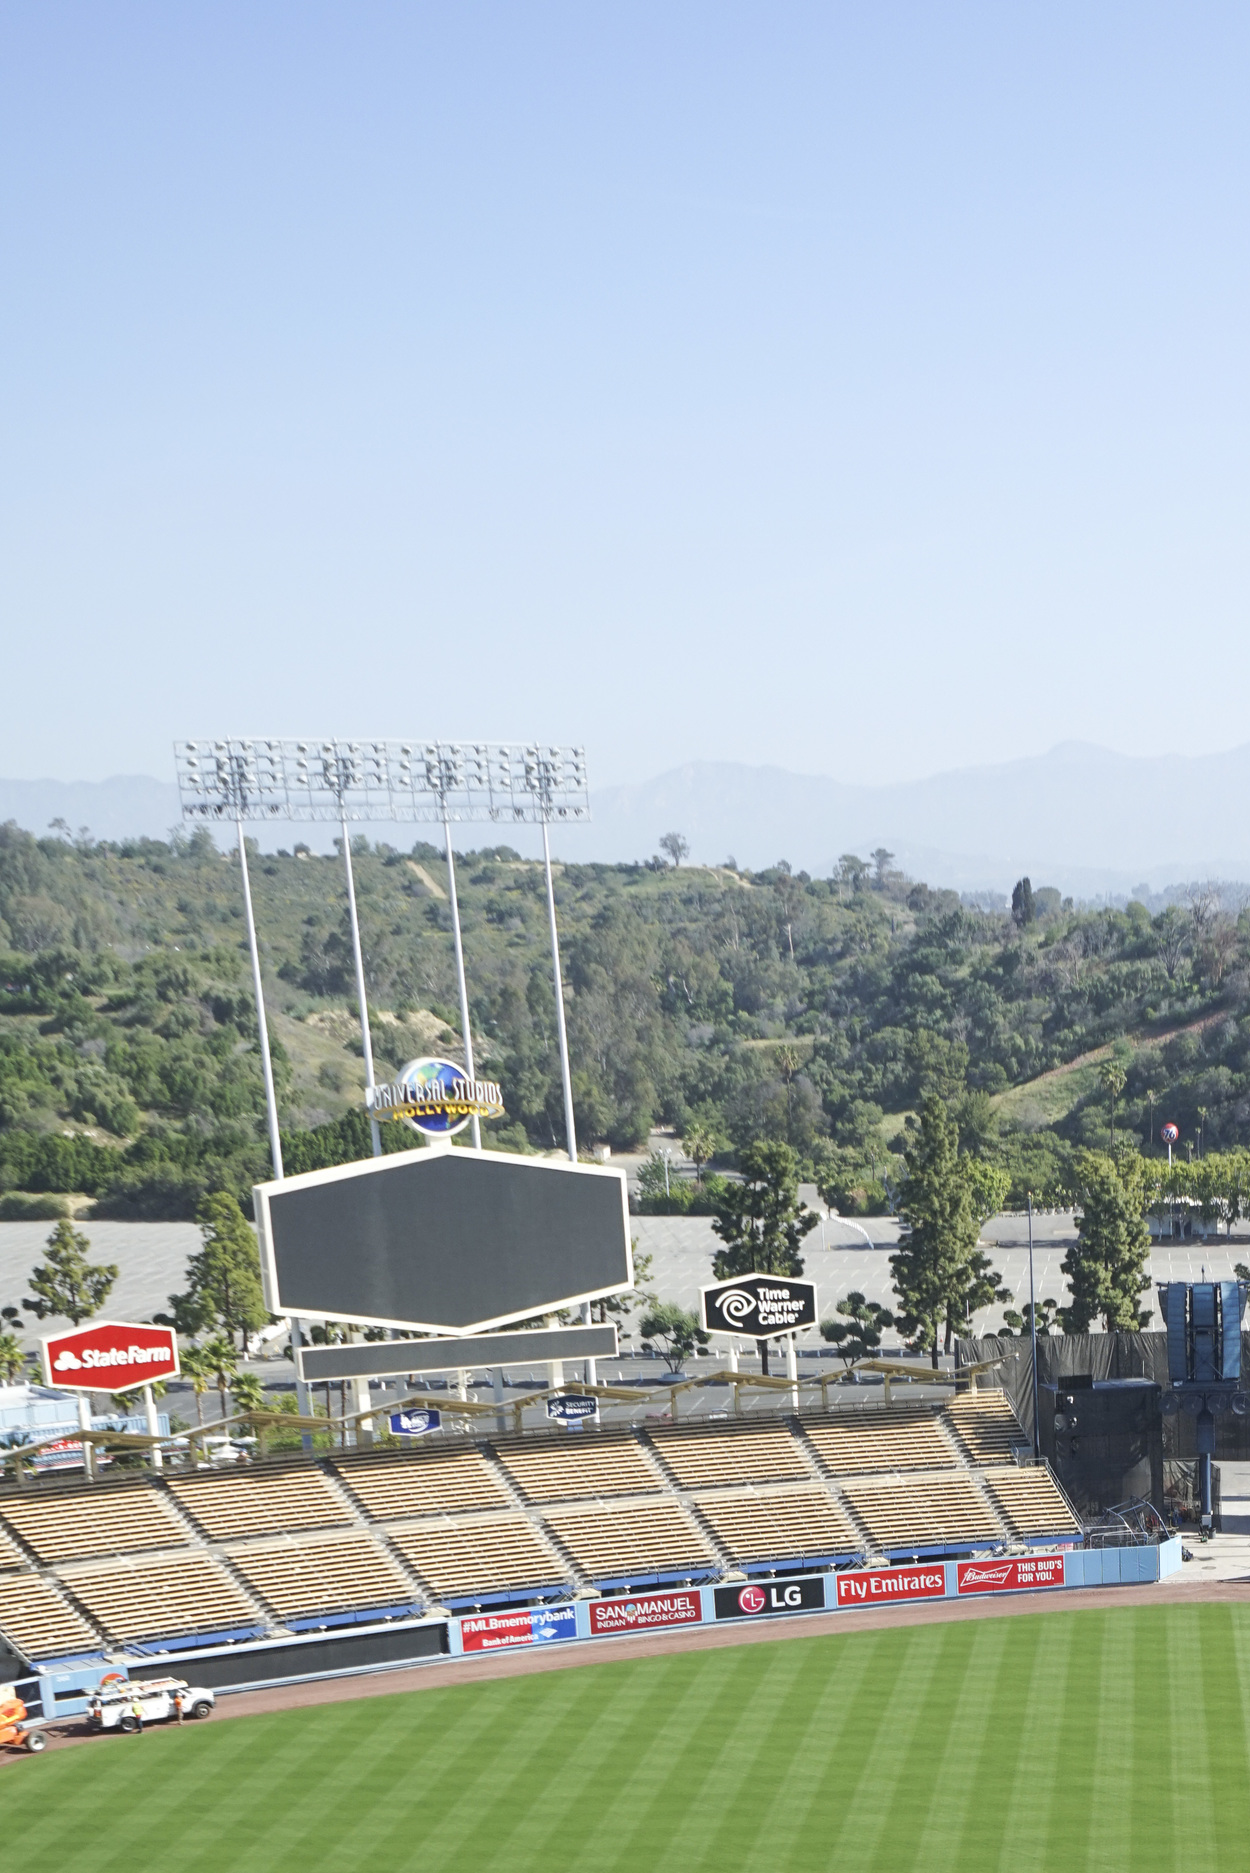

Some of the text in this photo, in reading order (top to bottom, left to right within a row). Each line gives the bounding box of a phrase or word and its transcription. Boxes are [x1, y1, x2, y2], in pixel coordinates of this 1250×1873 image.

[374, 1077, 503, 1110] UNIVERSAL STUDIOS
[393, 1104, 490, 1120] HOLLYWOOD
[757, 1288, 790, 1300] Time
[757, 1300, 805, 1313] Warner
[565, 1400, 595, 1408] SECURITY
[565, 1407, 592, 1415] BENEFIT
[1017, 1559, 1062, 1572] THIS BUD'S
[965, 1570, 1007, 1583] Budweiser
[1017, 1570, 1055, 1583] FOR YOU.
[839, 1573, 943, 1598] Fly Emirates
[771, 1585, 802, 1608] LG
[595, 1597, 695, 1620] SAN MANUEL
[463, 1607, 575, 1633] #MLBmemorybank
[597, 1618, 626, 1629] INDIAN
[482, 1637, 501, 1647] Bank
[509, 1632, 539, 1643] America
